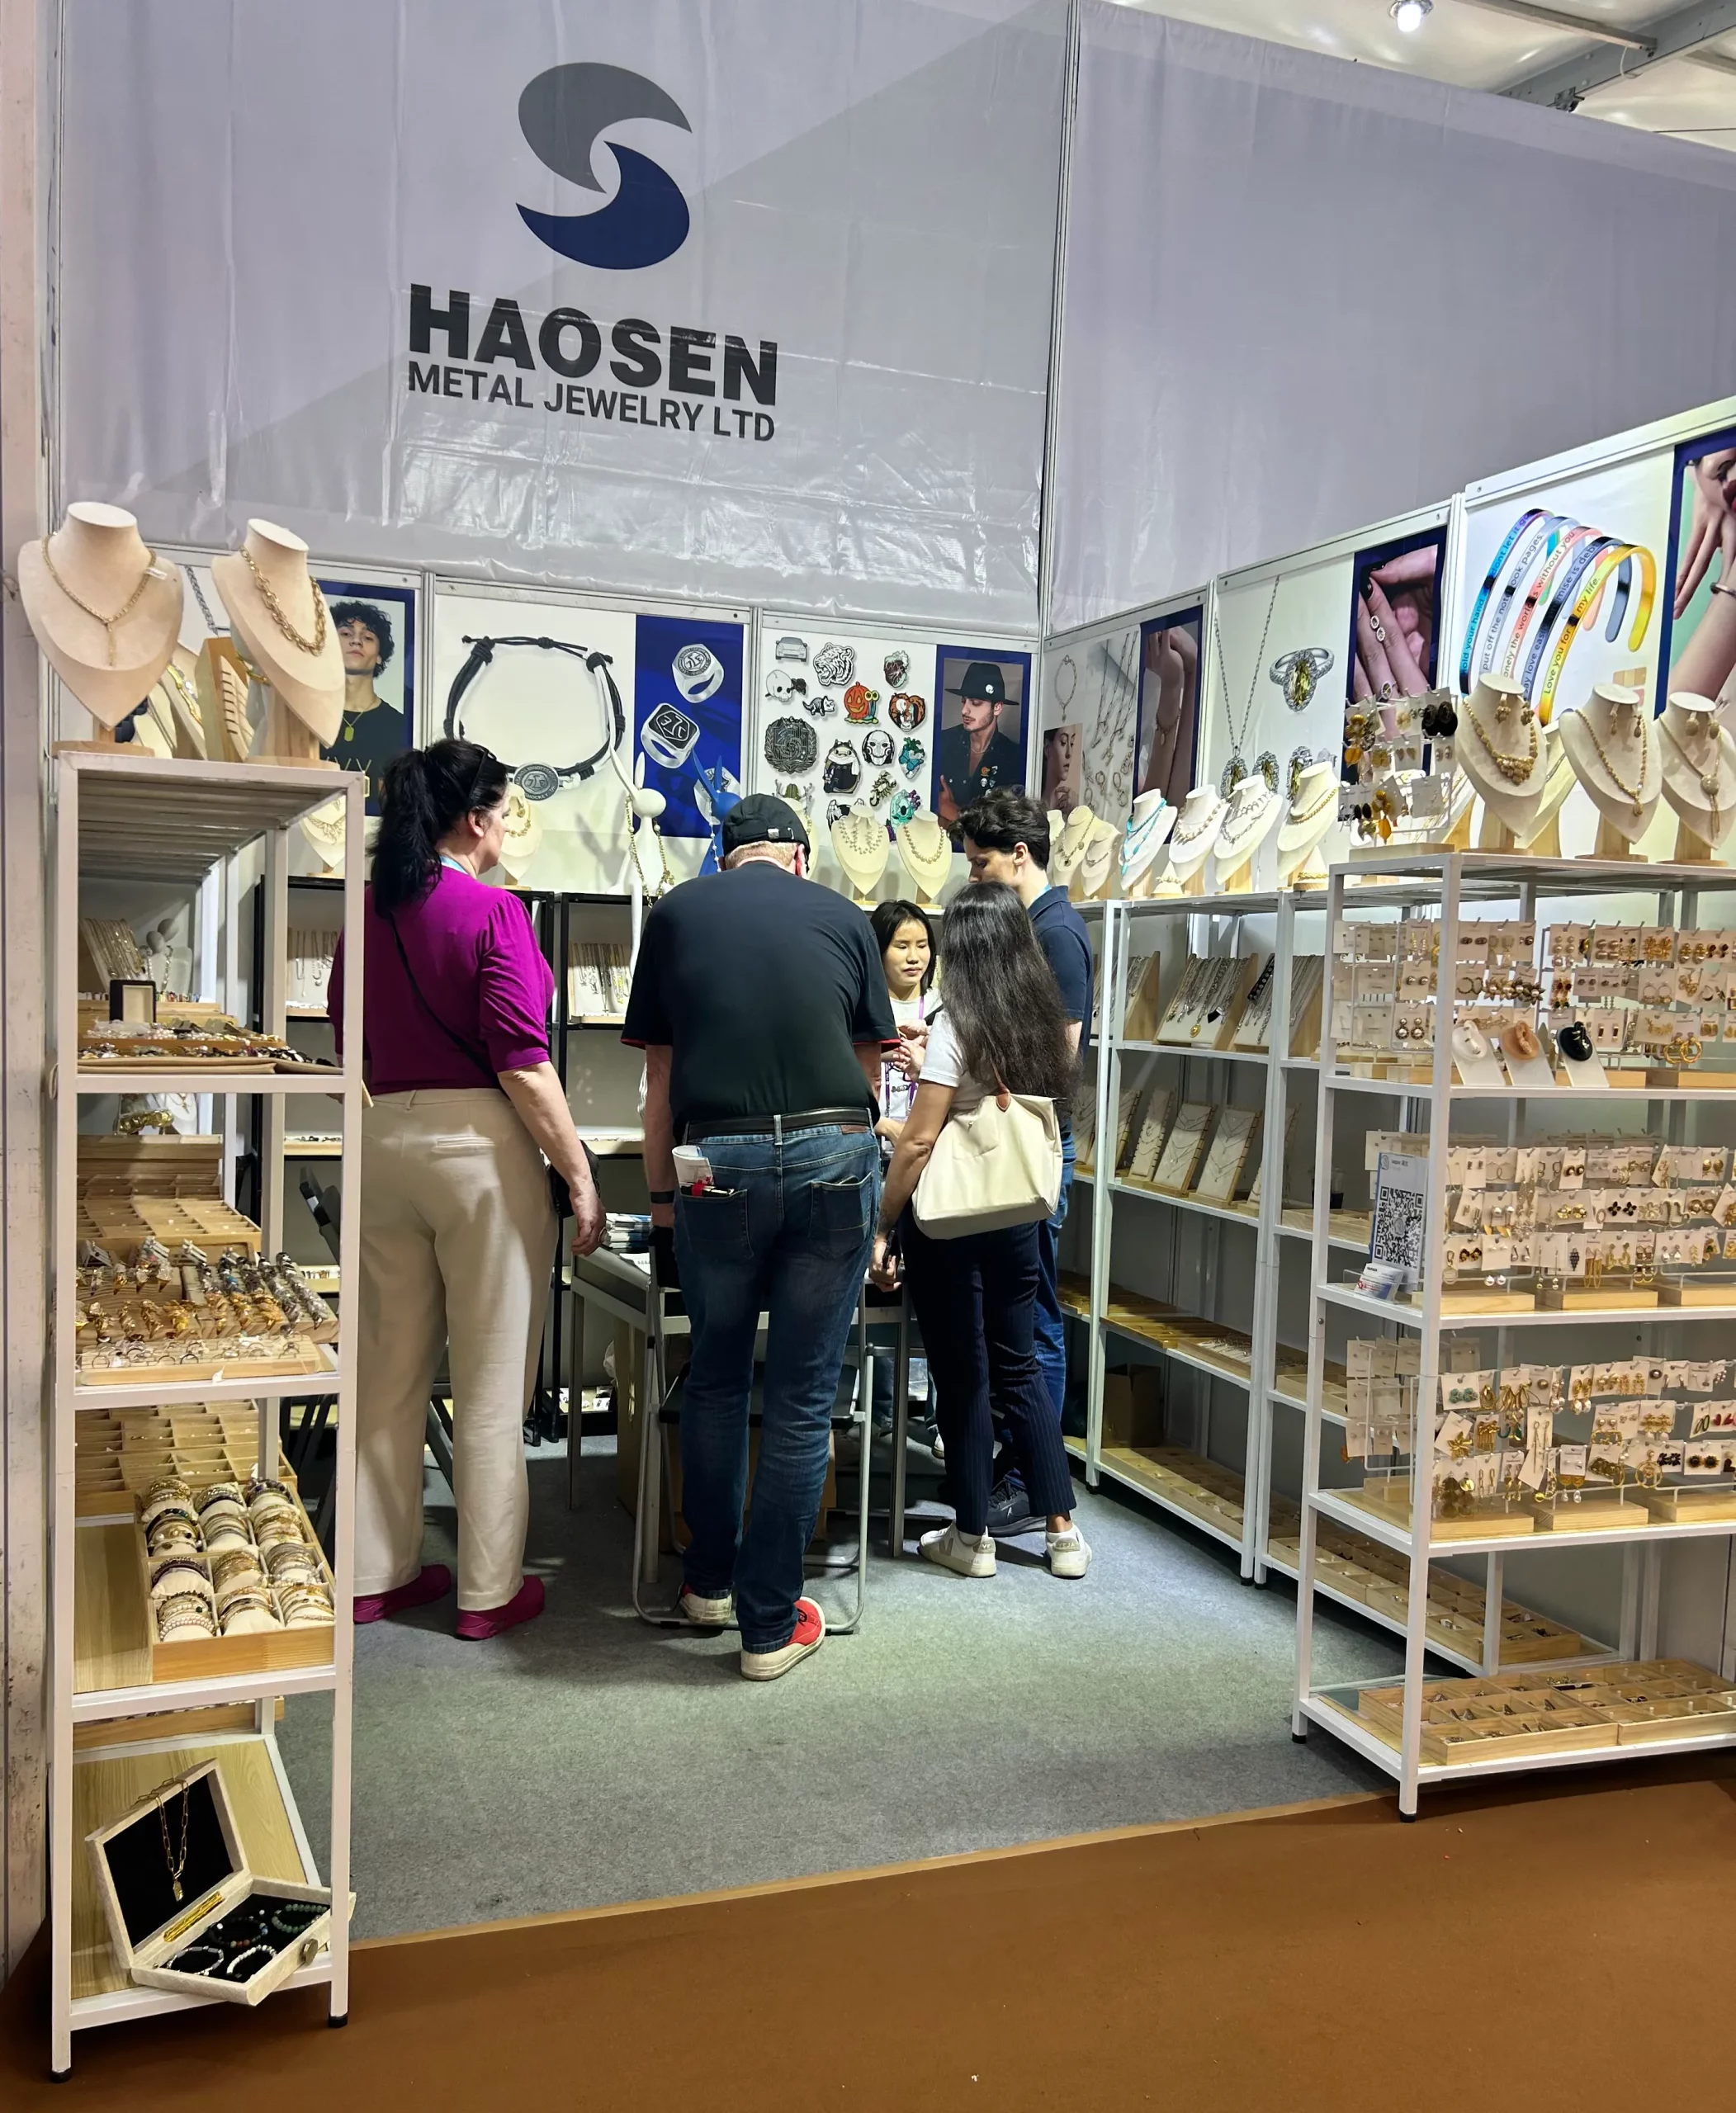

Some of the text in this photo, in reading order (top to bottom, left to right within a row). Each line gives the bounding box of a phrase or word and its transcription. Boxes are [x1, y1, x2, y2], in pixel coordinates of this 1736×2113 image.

[409, 283, 778, 405] HAOSEN
[409, 361, 774, 442] METAL JEWELRY LTD
[1465, 627, 1476, 650] your
[1472, 599, 1484, 624] hand
[1492, 551, 1507, 576] dont
[1504, 535, 1515, 550] let
[1512, 527, 1520, 535] it
[1519, 513, 1530, 527] go
[1510, 631, 1521, 649] the
[1518, 602, 1534, 631] world
[1536, 549, 1563, 589] without
[1560, 531, 1576, 550] you
[1527, 652, 1538, 674] love
[1572, 566, 1580, 575] is
[1483, 652, 1491, 671] put
[1487, 635, 1495, 650] off
[1491, 617, 1501, 633] the
[1544, 669, 1556, 694] Love
[1553, 647, 1564, 667] you
[1560, 627, 1571, 645] for
[1576, 595, 1588, 613] my
